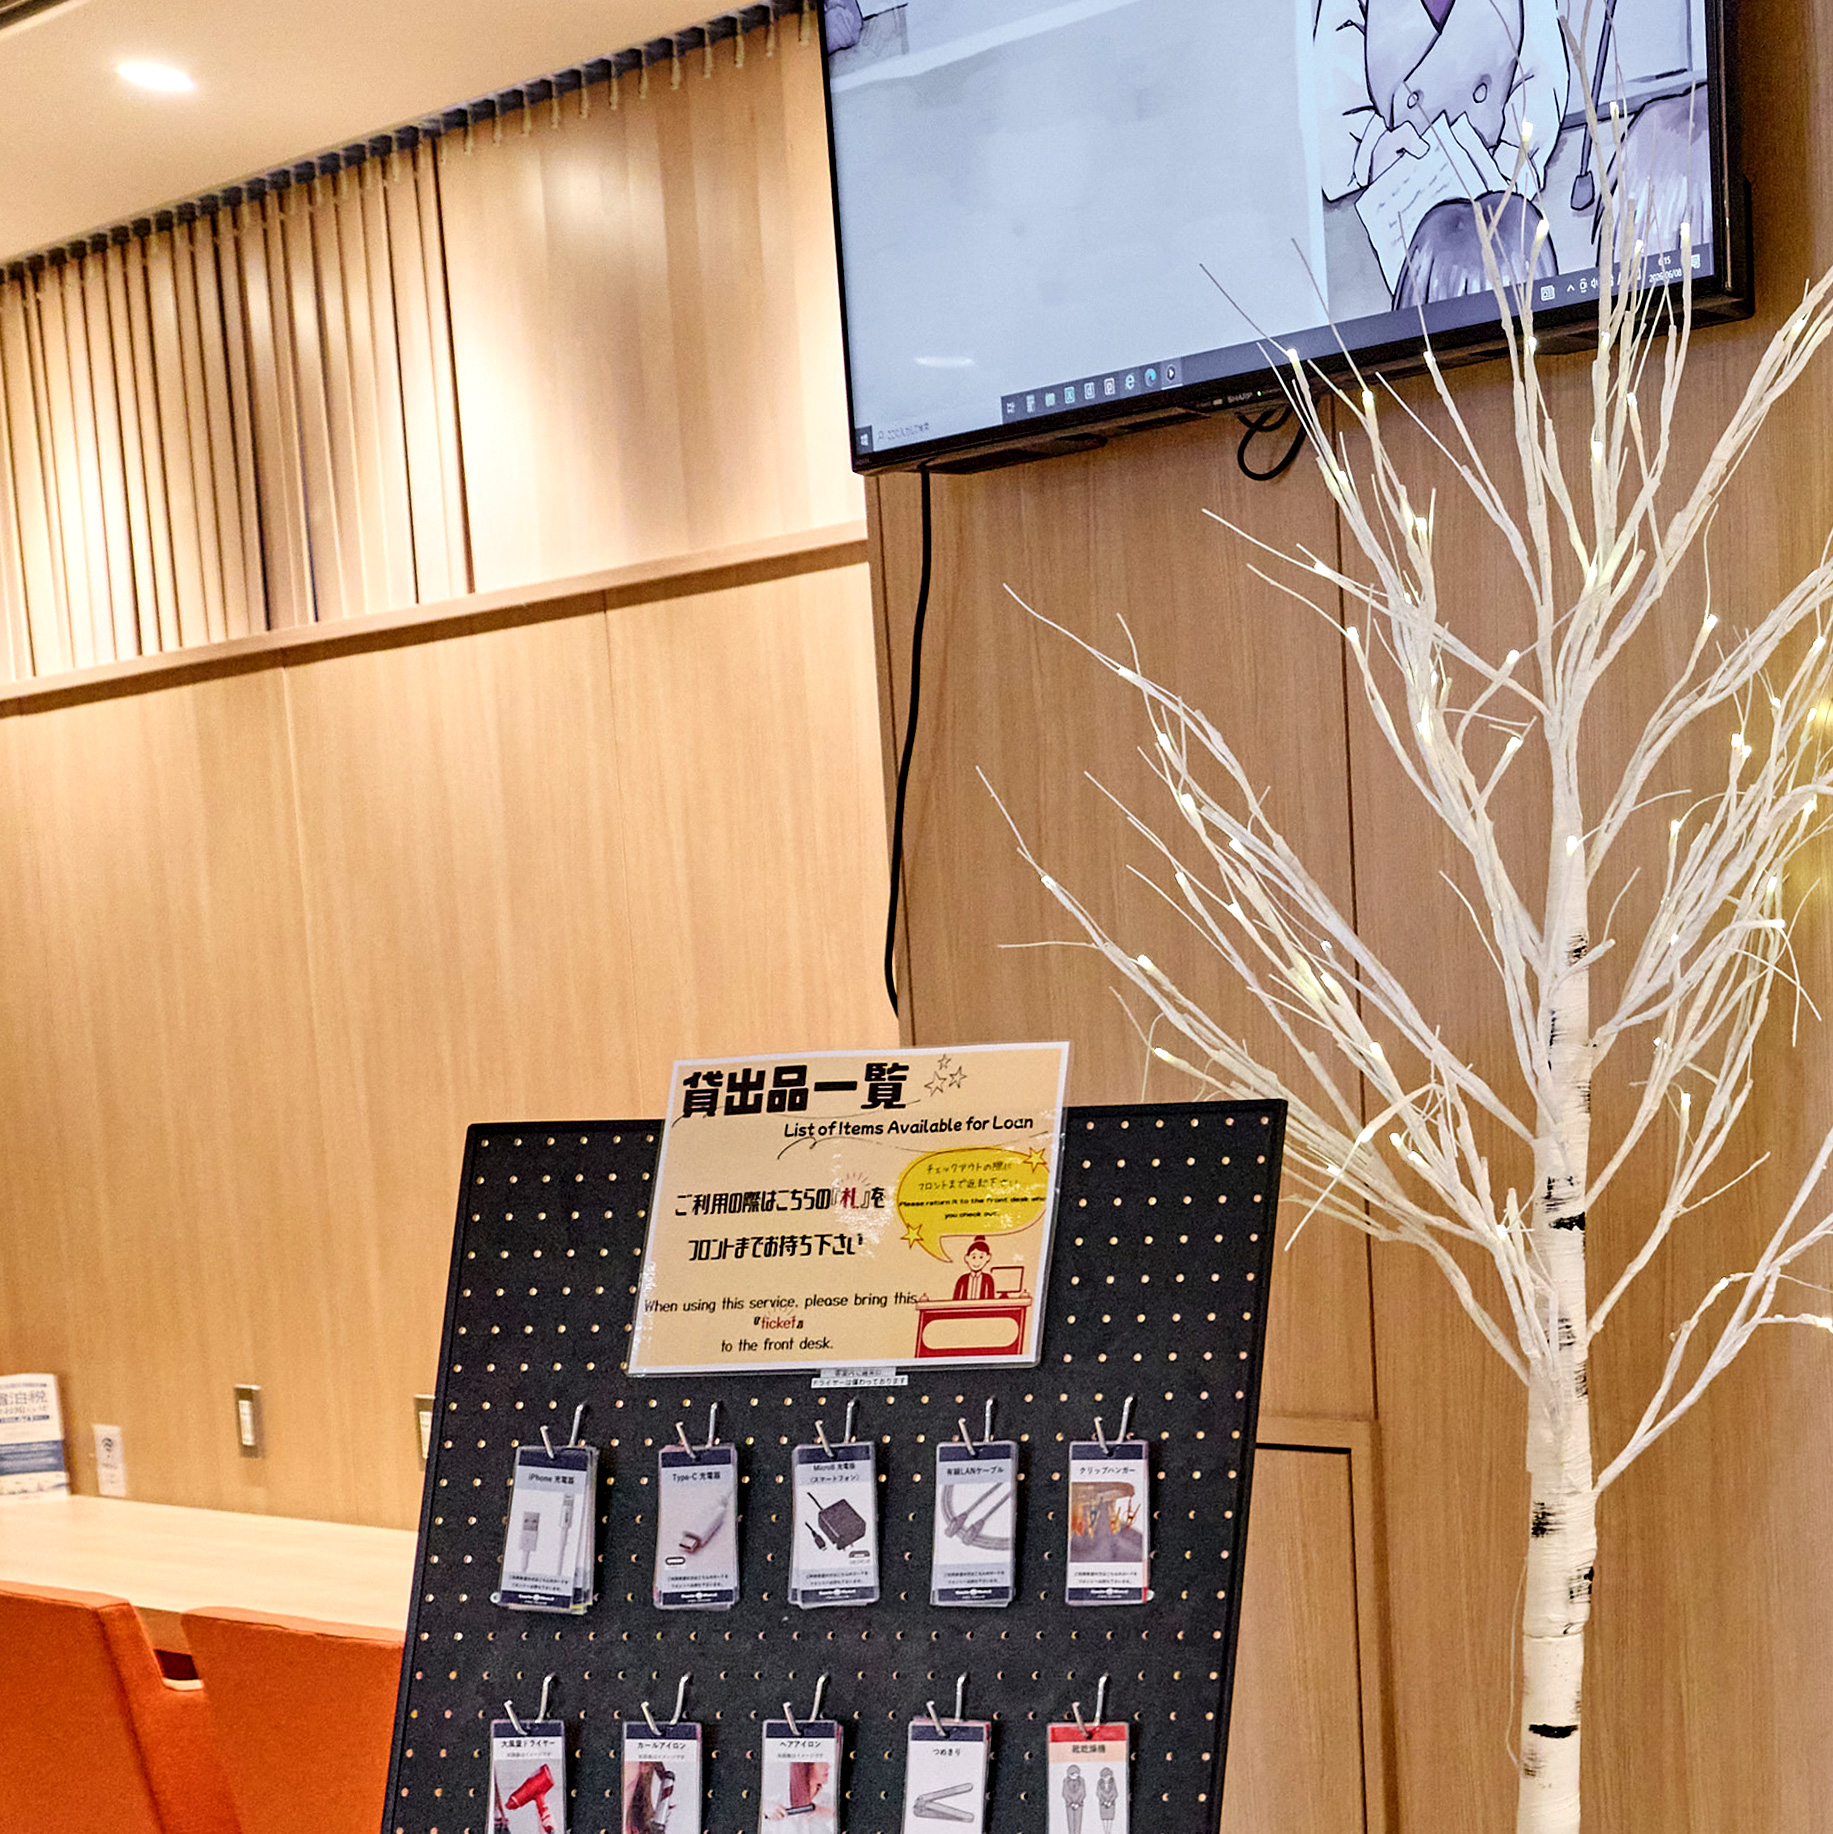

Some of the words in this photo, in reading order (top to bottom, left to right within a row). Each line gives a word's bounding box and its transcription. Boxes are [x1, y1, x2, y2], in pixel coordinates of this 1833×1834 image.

[680, 1062, 910, 1118] 貸出品一覧
[784, 1122, 813, 1137] List
[818, 1120, 835, 1136] of
[838, 1121, 883, 1136] Items
[887, 1117, 961, 1134] Available
[966, 1116, 988, 1131] for
[993, 1115, 1033, 1130] Loan
[675, 1186, 886, 1216] ご利用の際はこちらの『札』を
[688, 1233, 864, 1262] フロントまでお持ち下さい
[645, 1299, 677, 1313] When
[683, 1299, 716, 1313] using
[722, 1297, 744, 1310] this
[804, 1295, 848, 1309] please
[854, 1293, 888, 1308] bring
[894, 1292, 917, 1305] this
[722, 1339, 733, 1353] to
[738, 1338, 758, 1351] the
[763, 1337, 794, 1351] front
[799, 1335, 834, 1350] desk.
